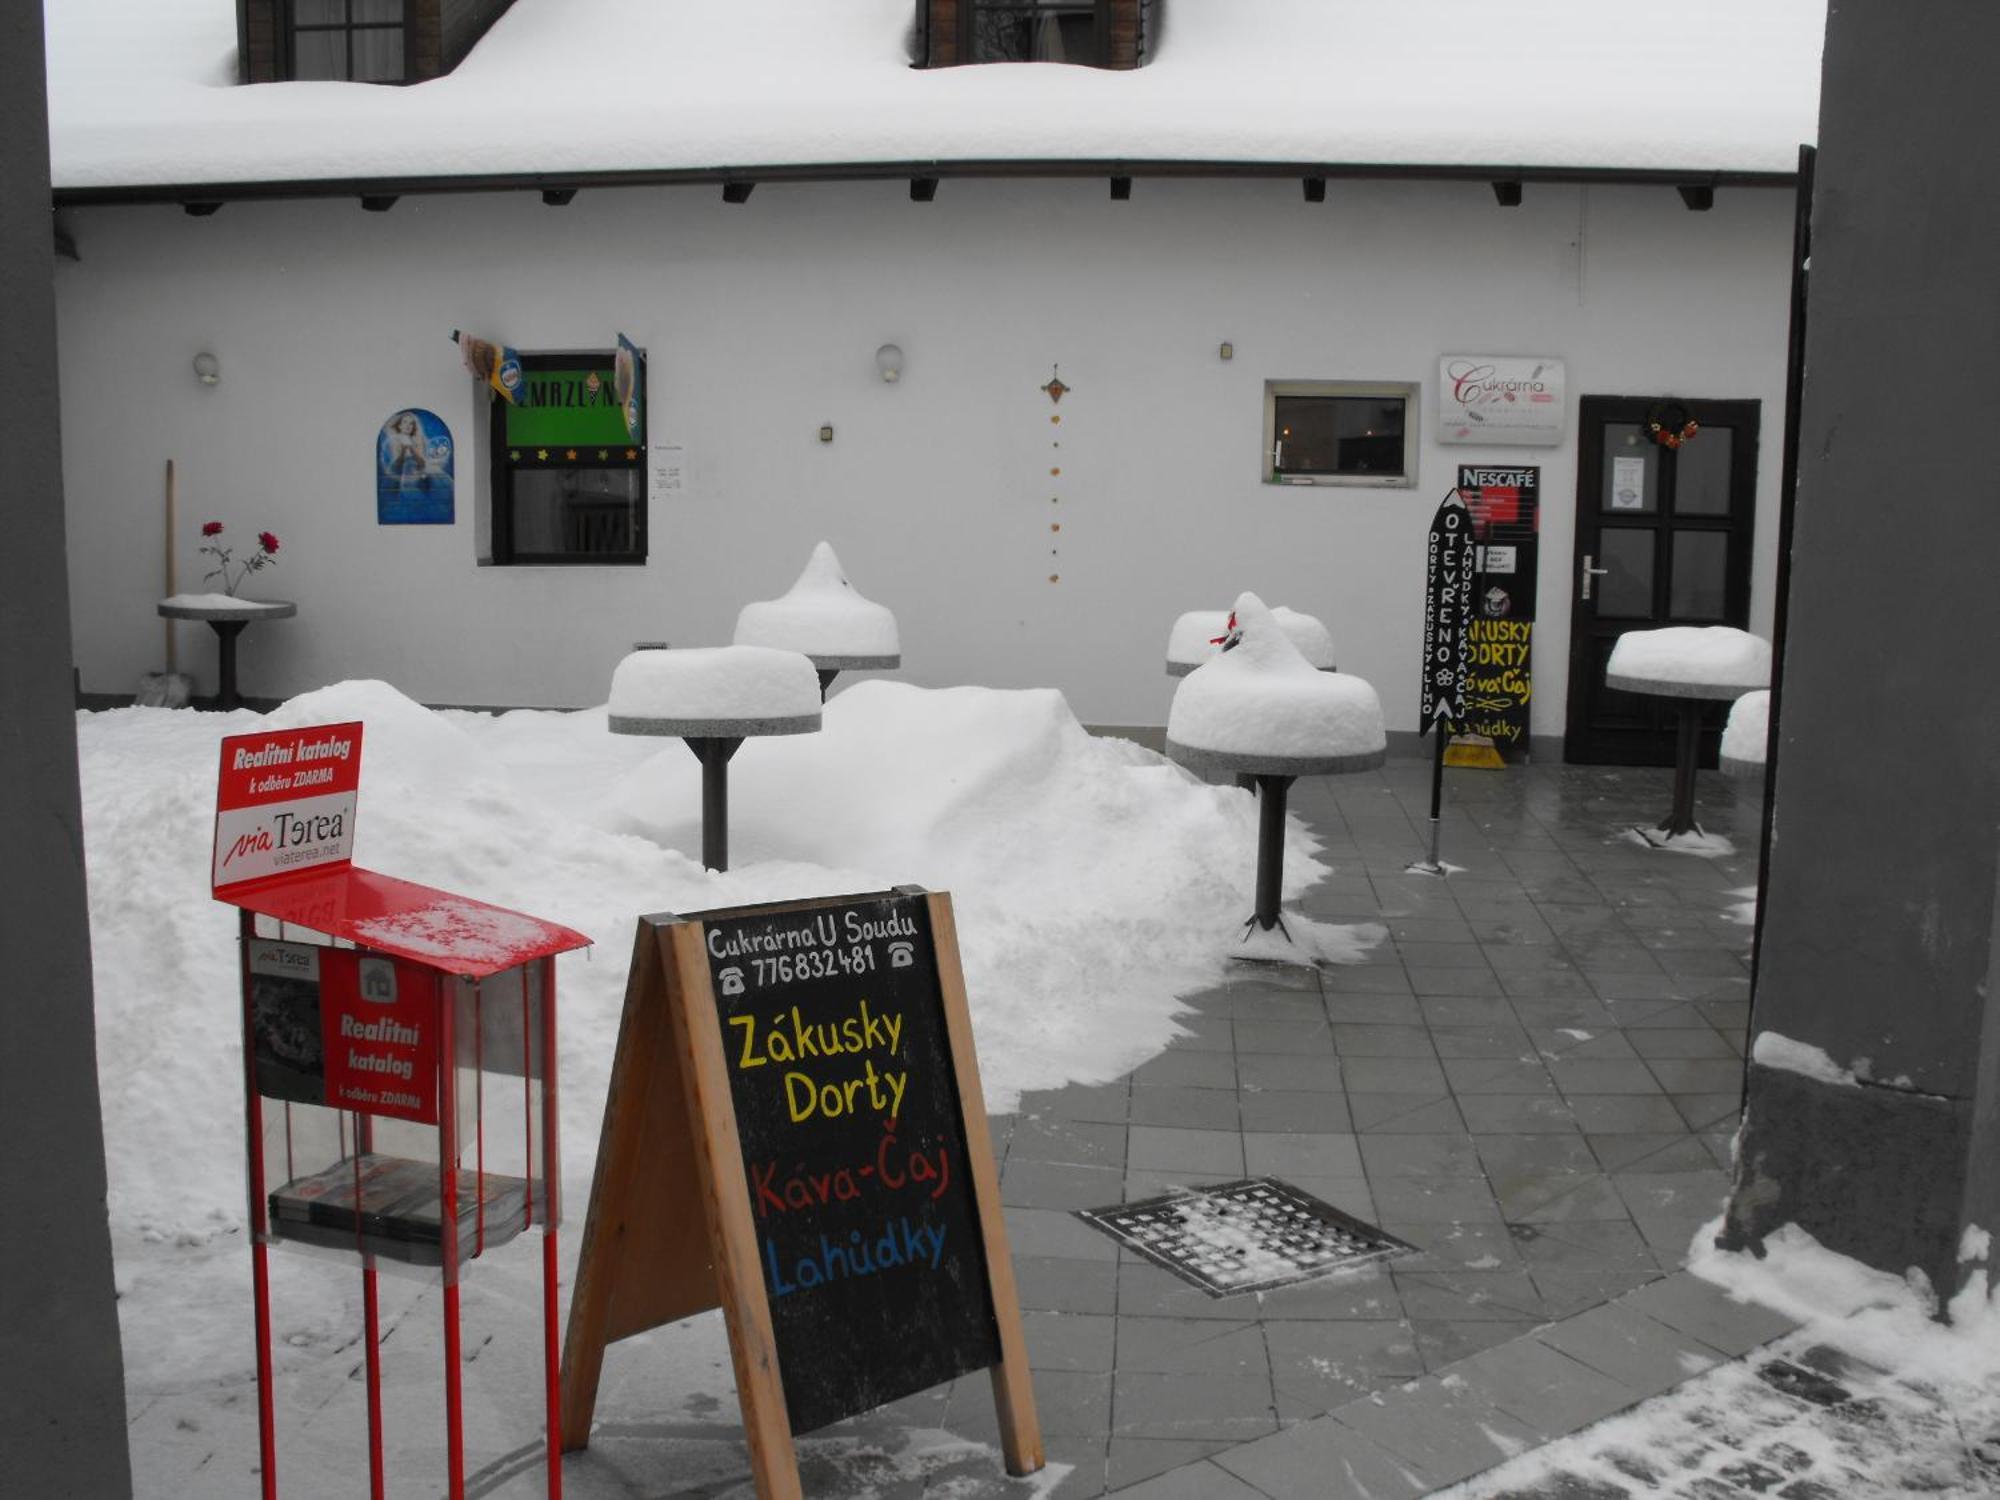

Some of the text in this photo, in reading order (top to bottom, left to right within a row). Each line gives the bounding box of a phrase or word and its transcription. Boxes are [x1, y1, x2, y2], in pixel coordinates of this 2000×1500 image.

[1447, 360, 1545, 406] Cukrárna
[1463, 468, 1535, 488] NESCAFÉ
[1429, 531, 1440, 584] DORTY
[1437, 513, 1460, 663] OTEVŘENO
[1423, 674, 1433, 714] LIMO
[233, 736, 352, 770] Realitní katalog
[249, 767, 334, 794] k odběru ZDARMA
[273, 842, 340, 866] viaterea.net
[707, 909, 918, 959] Cukrárna U Soudu
[340, 1013, 420, 1046] Realitní
[729, 999, 903, 1069] Zákusky
[348, 1048, 414, 1080] katalog
[784, 1059, 907, 1123] Dorty
[767, 1216, 947, 1297] Lahůdky
